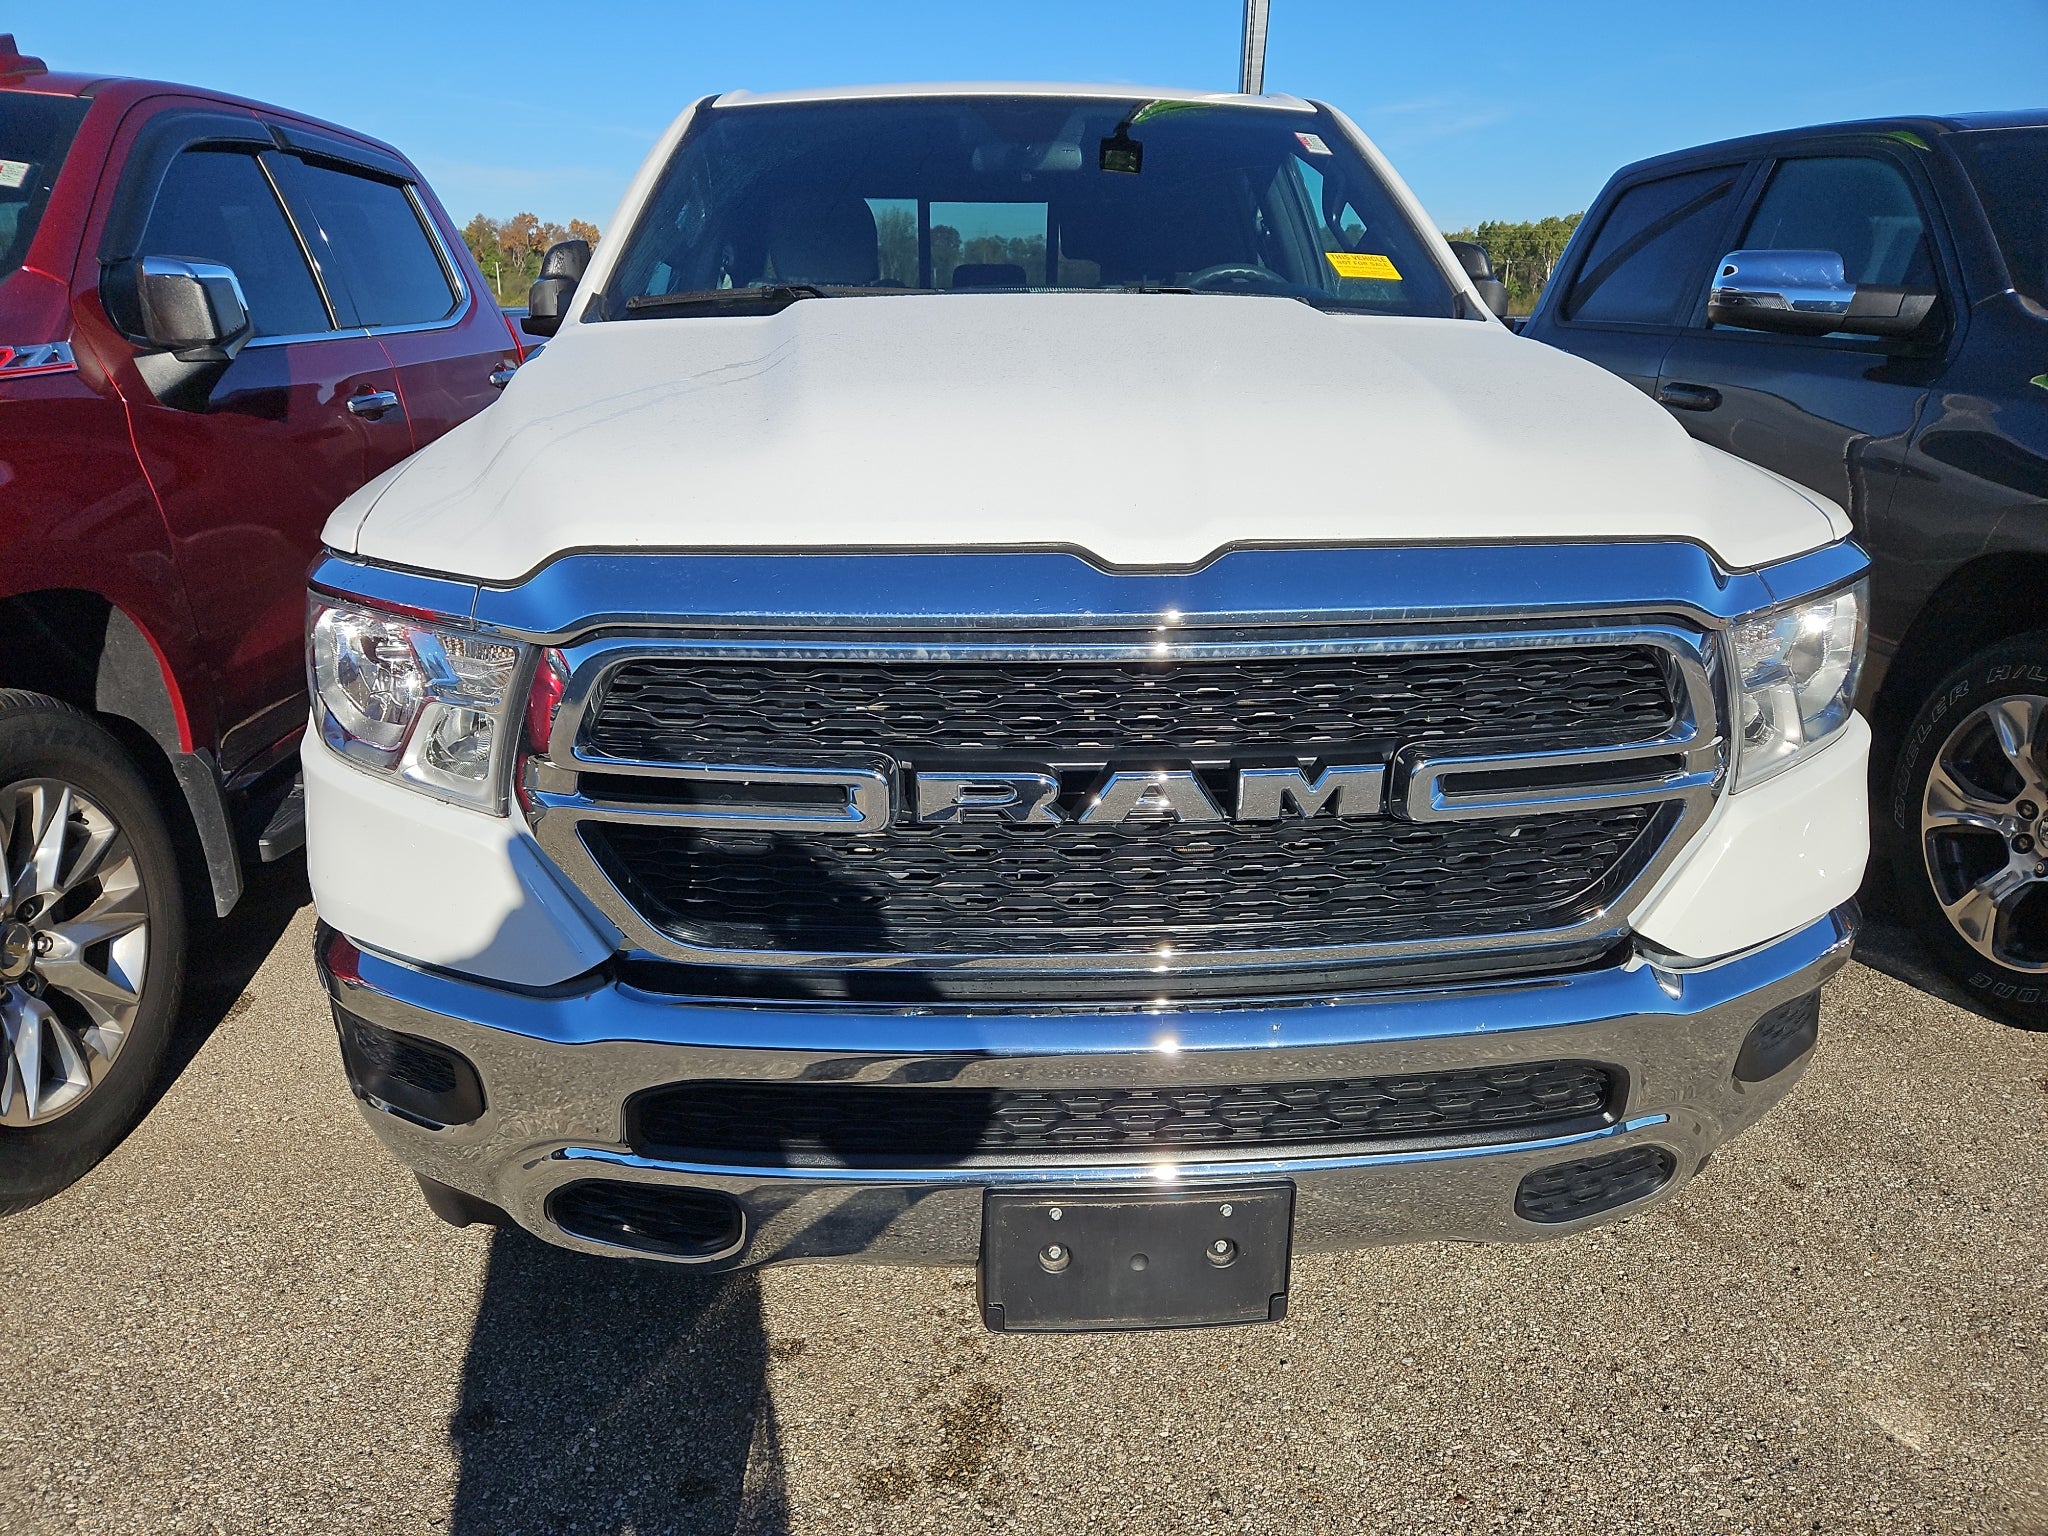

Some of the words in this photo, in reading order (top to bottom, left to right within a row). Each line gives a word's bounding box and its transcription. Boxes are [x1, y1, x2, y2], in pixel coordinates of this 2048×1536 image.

[1352, 255, 1387, 263] VEHICLE
[1894, 680, 1969, 829] DUELER
[916, 764, 1387, 823] RAM
[1969, 972, 2041, 1003] ONE
